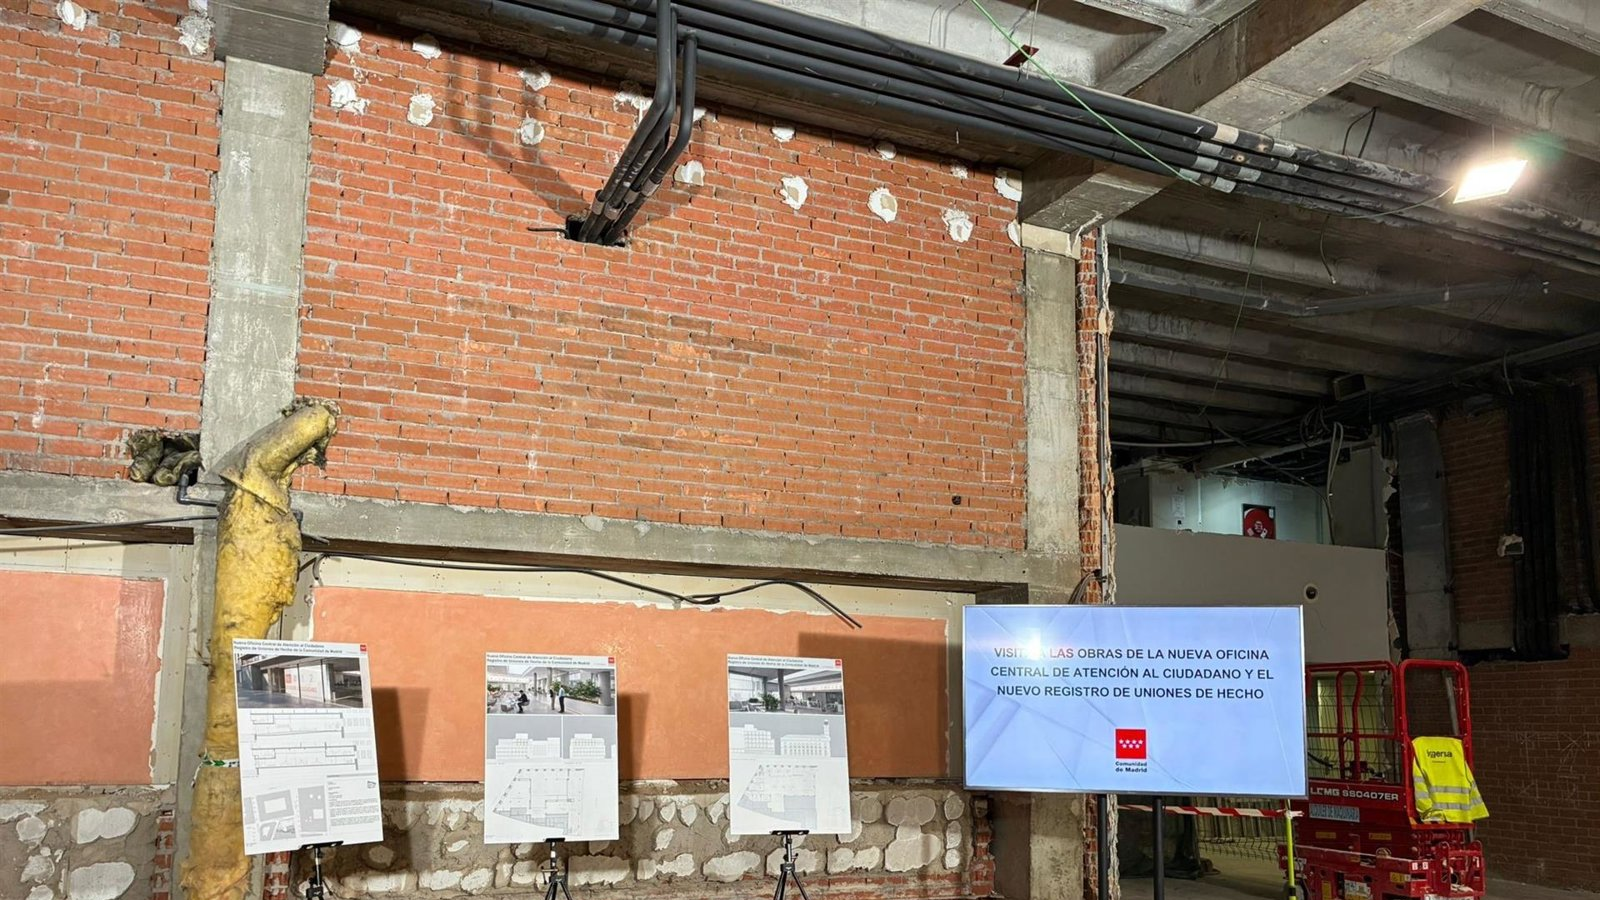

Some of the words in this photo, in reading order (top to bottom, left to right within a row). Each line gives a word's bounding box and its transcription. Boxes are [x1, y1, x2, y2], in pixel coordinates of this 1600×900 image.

[994, 648, 1031, 658] VISIT
[1050, 648, 1074, 658] LAS
[1078, 648, 1123, 659] OBRAS
[1126, 649, 1143, 659] DE
[1147, 649, 1164, 659] LA
[1168, 649, 1212, 659] NUEVA
[1216, 650, 1269, 660] OFICINA
[991, 666, 1049, 677] CENTRAL
[1053, 667, 1070, 677] DE
[1073, 666, 1138, 678] ATENCIÓN
[1142, 668, 1159, 678] AL
[1163, 668, 1241, 679] CIUDADANO
[1245, 669, 1253, 679] Y
[1258, 670, 1274, 679] EL
[997, 686, 1040, 696] NUEVO
[1045, 686, 1109, 697] REGISTRO
[1114, 687, 1130, 697] DE
[1134, 688, 1191, 698] UNIONES
[1196, 688, 1213, 698] DE
[1217, 688, 1264, 699] HECHO
